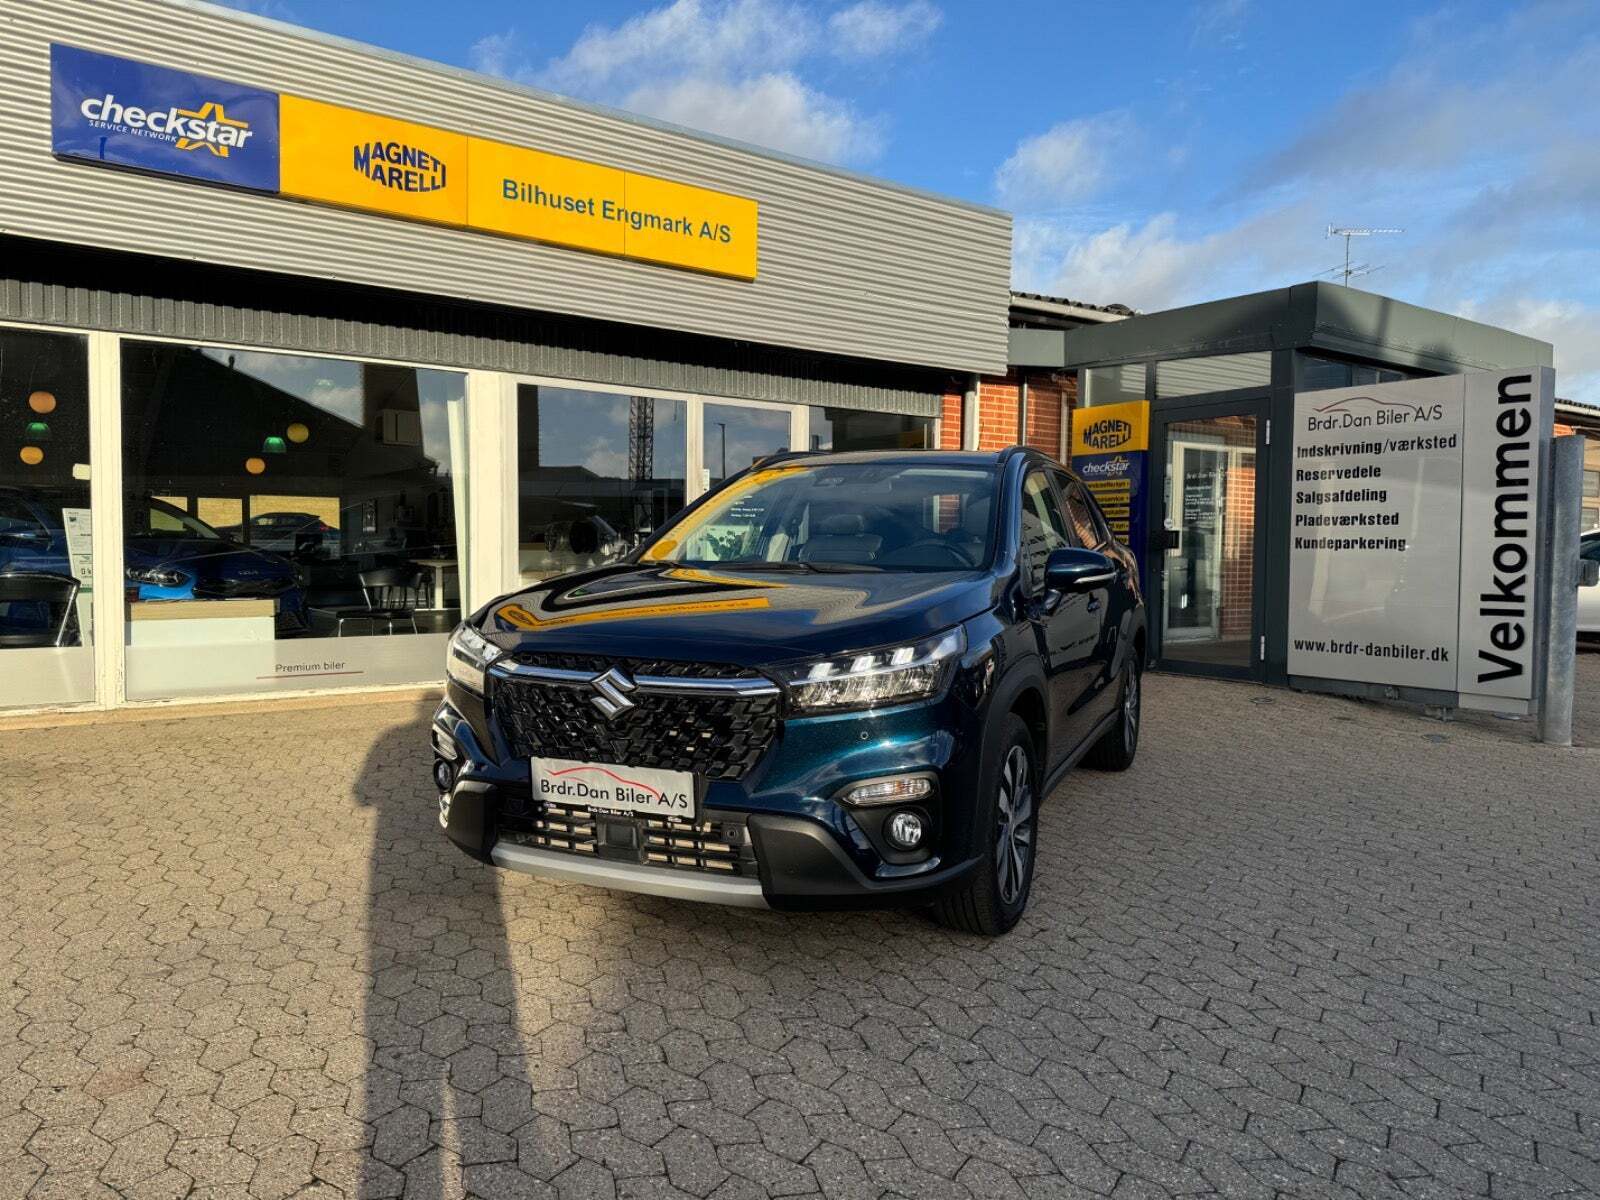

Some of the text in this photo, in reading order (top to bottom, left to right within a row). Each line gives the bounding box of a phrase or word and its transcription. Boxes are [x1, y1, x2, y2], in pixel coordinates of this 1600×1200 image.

[81, 94, 252, 147] checkstar
[89, 120, 177, 142] SERVICE NETWORK
[353, 142, 446, 176] MAGNETI
[353, 163, 446, 192] MARELLI
[502, 179, 731, 243] Bilhuset Engmark A/S
[1376, 409, 1410, 425] Biler
[1414, 404, 1443, 421] A/S
[1297, 433, 1457, 458] Indskrivning/værksted
[1082, 461, 1129, 473] checkstar
[1296, 465, 1381, 481] Reservedele
[1296, 488, 1387, 505] Salgsafdeling
[1295, 512, 1399, 526] Pladeværksted
[1477, 373, 1532, 683] Velkommen
[1295, 536, 1406, 551] Kundeparkering
[1294, 639, 1449, 662] www.brdr-danbiler.dk
[275, 661, 346, 672] Premium biler
[615, 787, 653, 804] Biler
[658, 792, 688, 808] A/S
